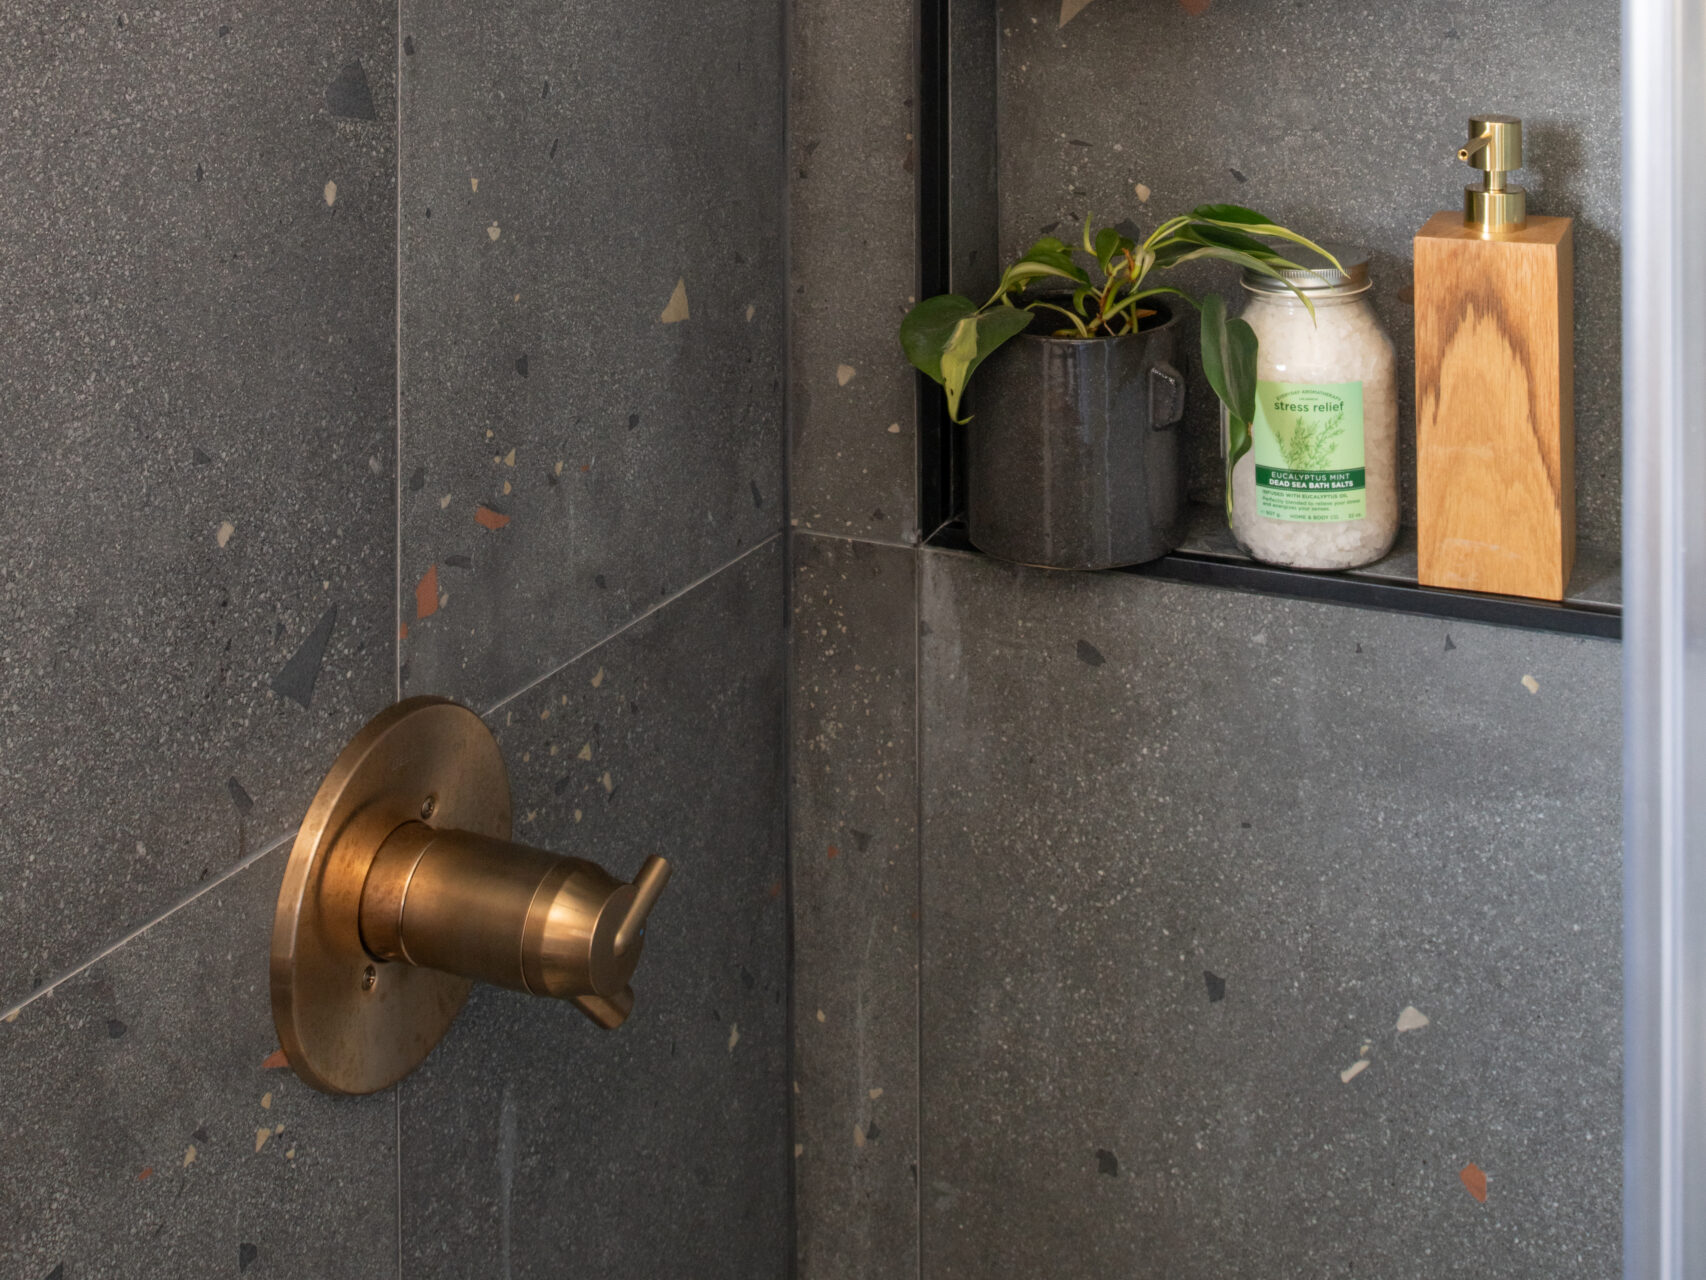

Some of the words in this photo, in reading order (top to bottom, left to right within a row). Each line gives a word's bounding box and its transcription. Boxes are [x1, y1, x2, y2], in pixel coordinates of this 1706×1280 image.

[1274, 402, 1309, 412] stress
[1313, 401, 1344, 412] relief
[1271, 471, 1327, 481] EUCALYPTUS
[1329, 472, 1350, 480] MINT
[1269, 478, 1289, 487] DEAD
[1331, 480, 1353, 488] SALTS
